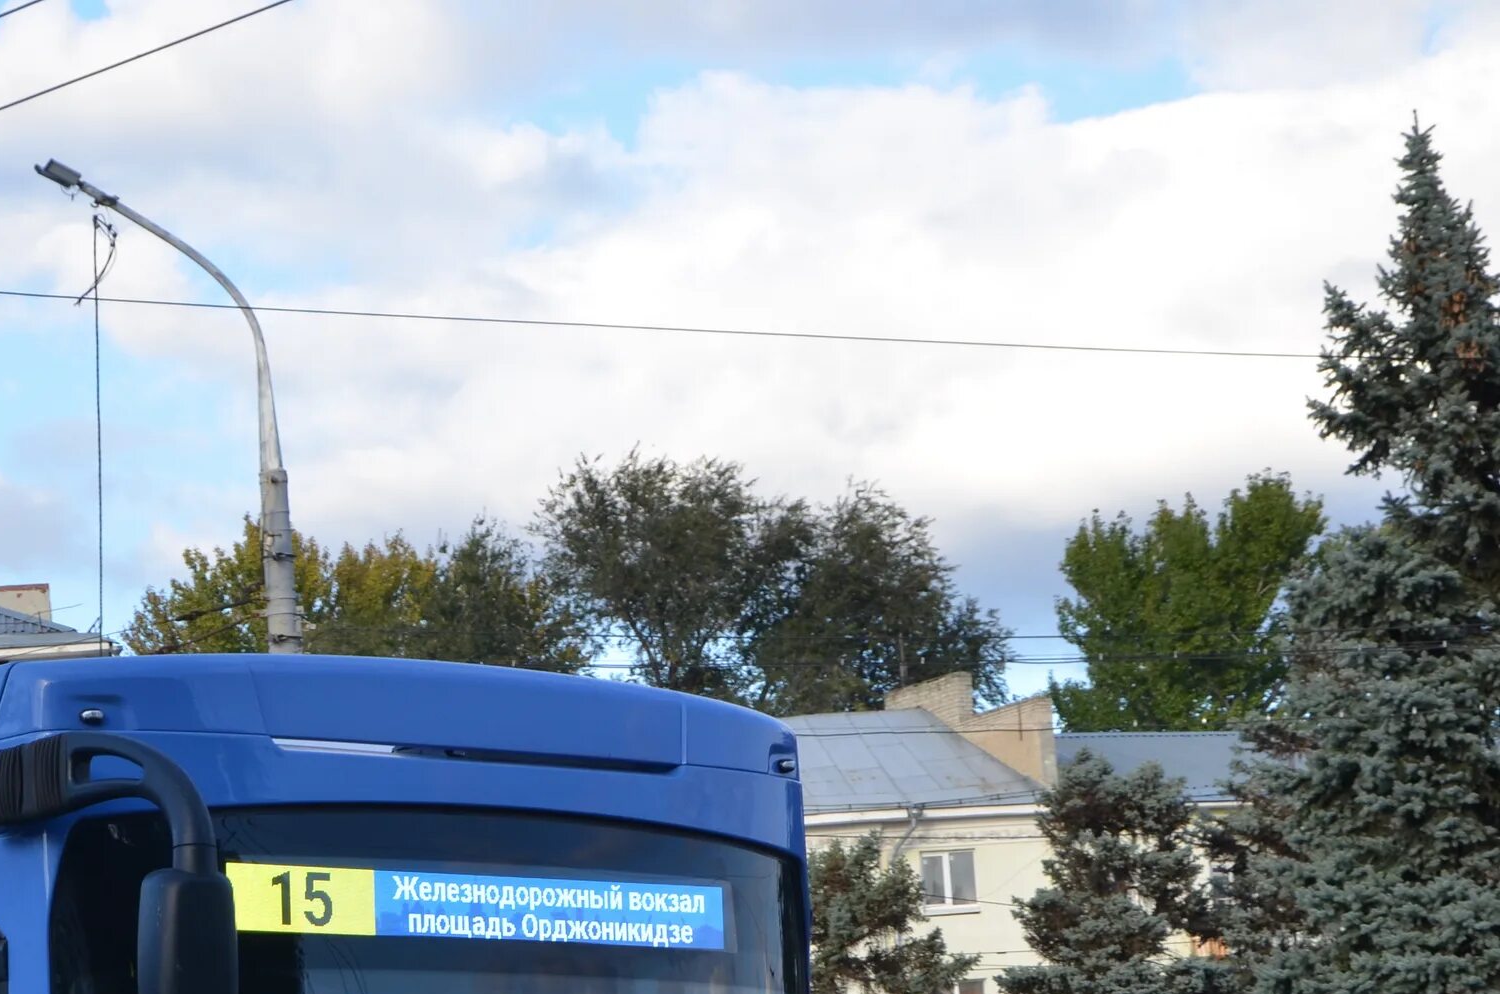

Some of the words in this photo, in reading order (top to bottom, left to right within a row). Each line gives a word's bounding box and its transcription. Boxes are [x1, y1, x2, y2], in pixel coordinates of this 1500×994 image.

[271, 871, 333, 926] 15
[393, 875, 623, 913] Железнодорожный
[629, 891, 705, 914] вокзал
[408, 911, 516, 940] площадь
[522, 914, 693, 947] Орджоникидзе
